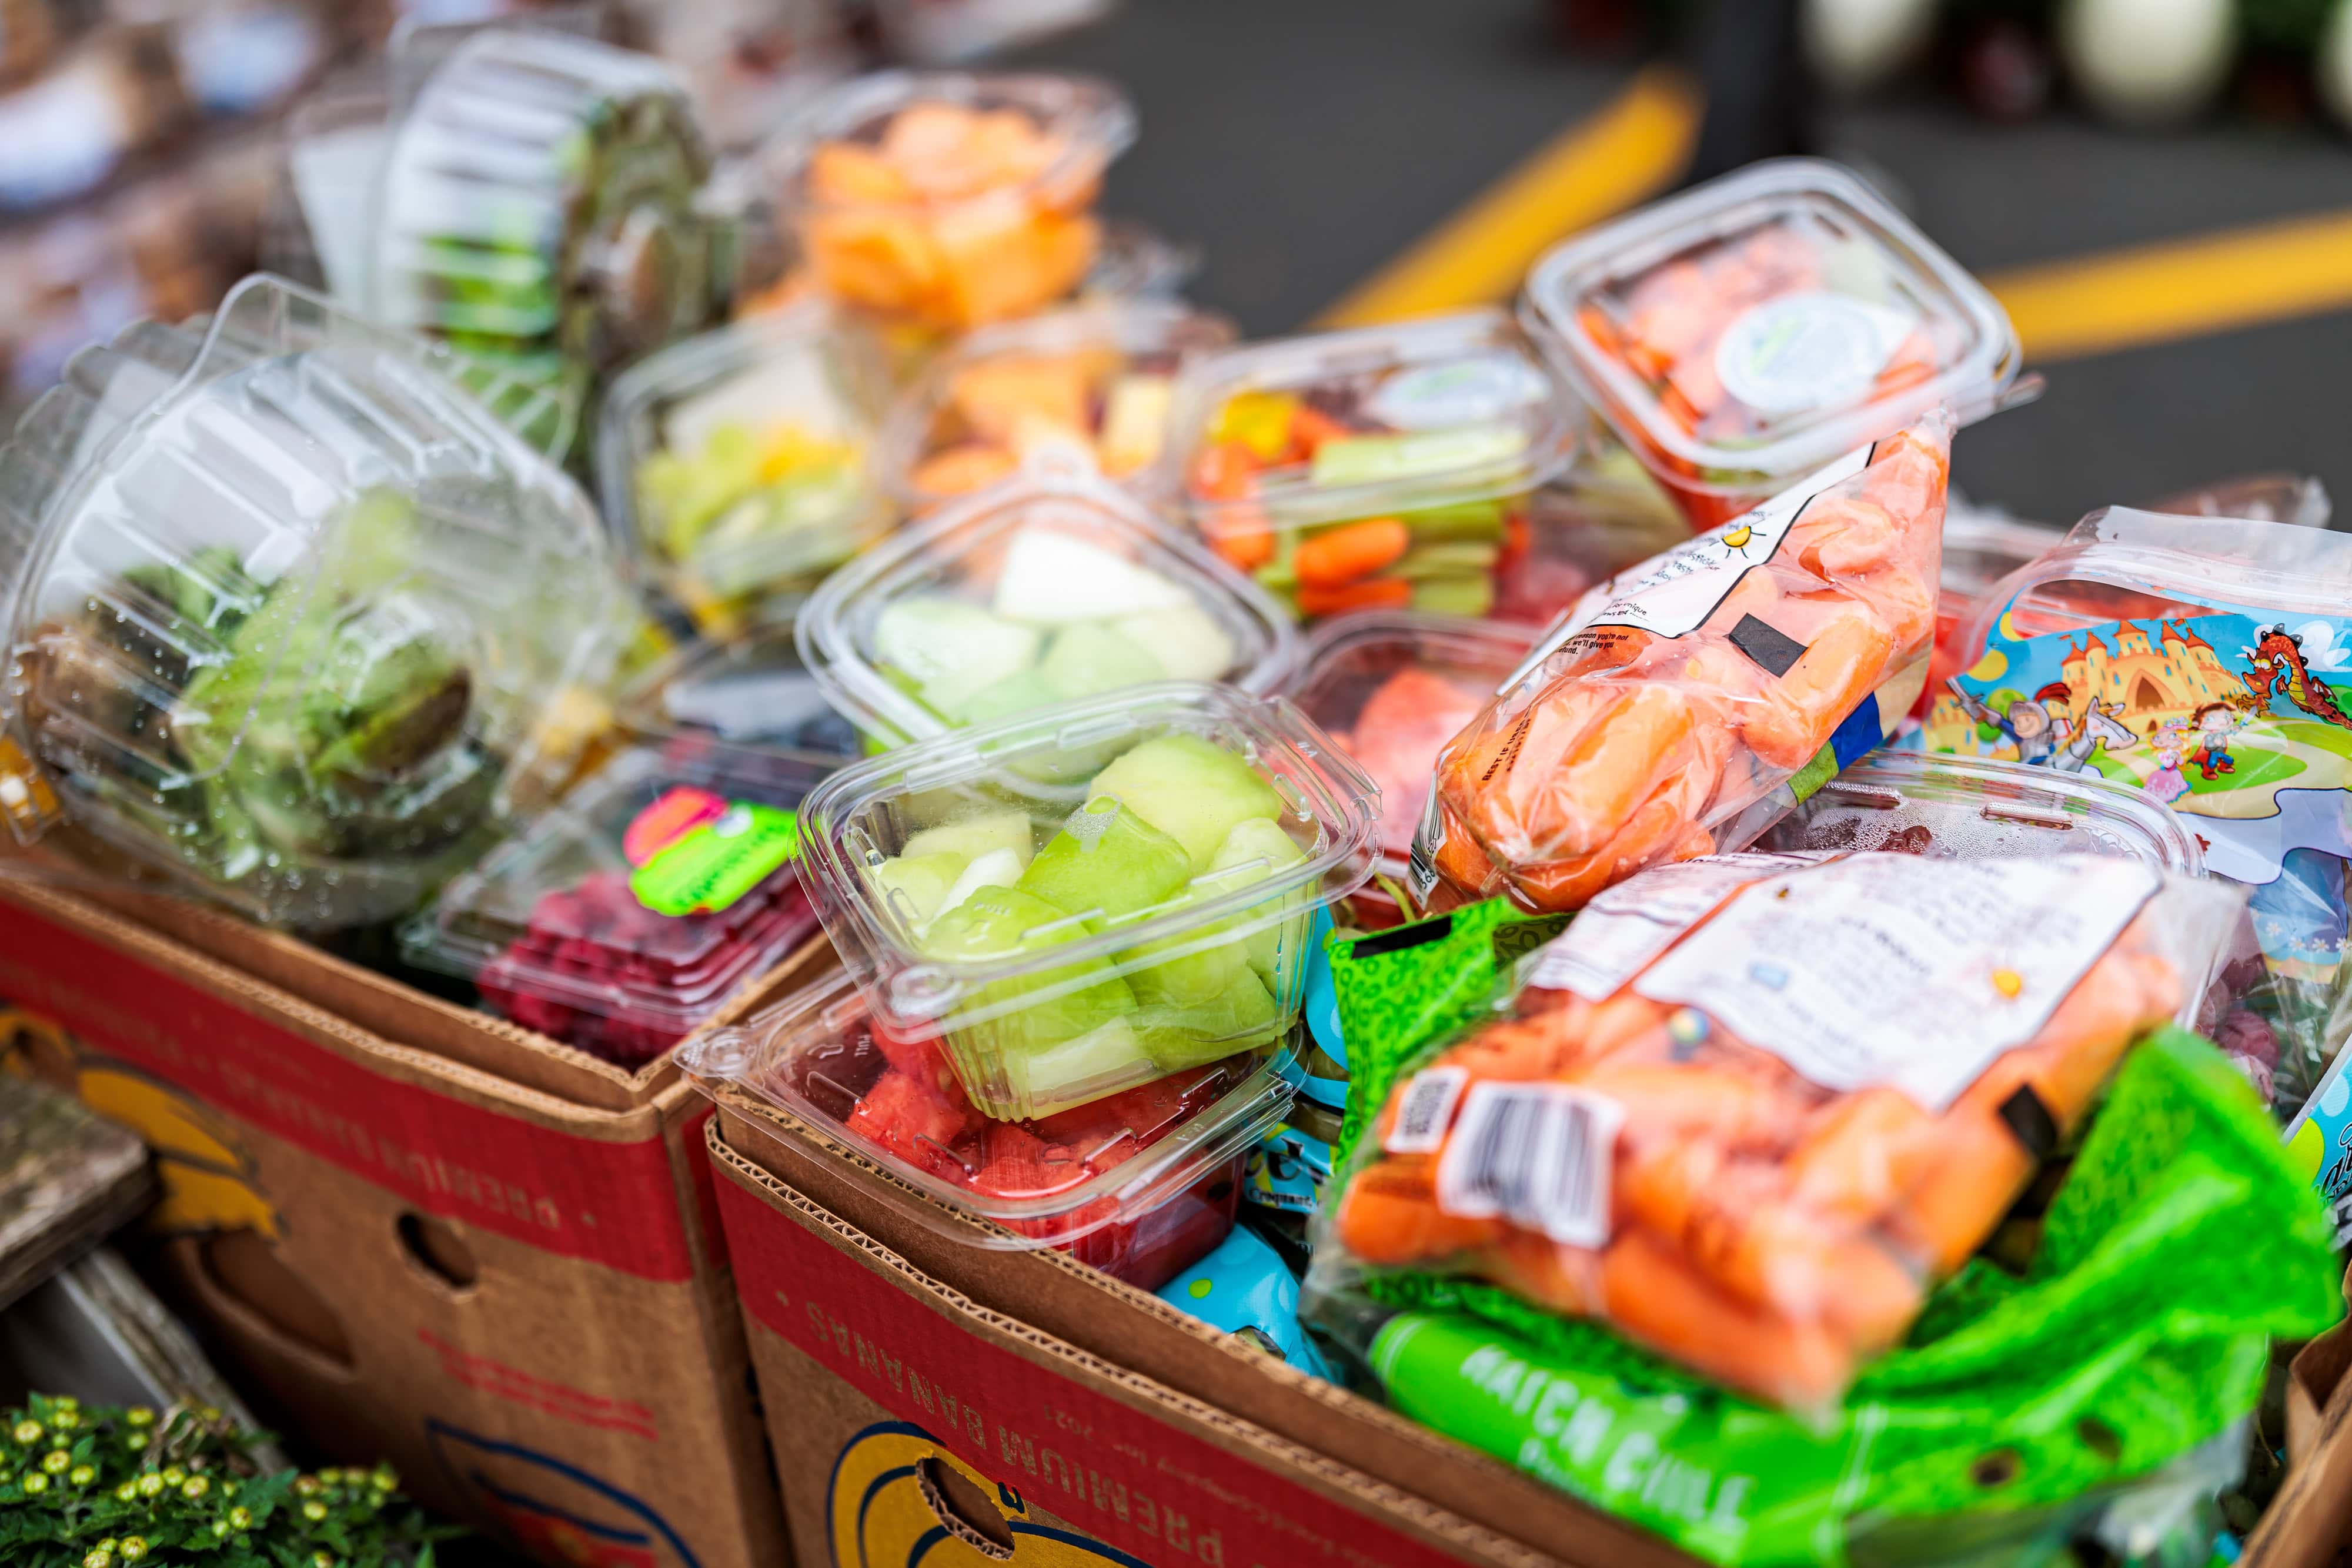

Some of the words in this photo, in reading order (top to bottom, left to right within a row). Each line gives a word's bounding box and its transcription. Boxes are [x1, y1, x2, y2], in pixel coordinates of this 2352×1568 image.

[1572, 639, 1588, 647] we'll
[1589, 641, 1605, 649] give
[1603, 641, 1615, 650] you
[1597, 632, 1616, 640] you're
[1557, 646, 1578, 655] efund.
[1482, 758, 1502, 781] BEST
[1499, 747, 1509, 755] IF
[806, 1300, 988, 1449] BANANAS
[998, 1423, 1226, 1568] PREMIUM
